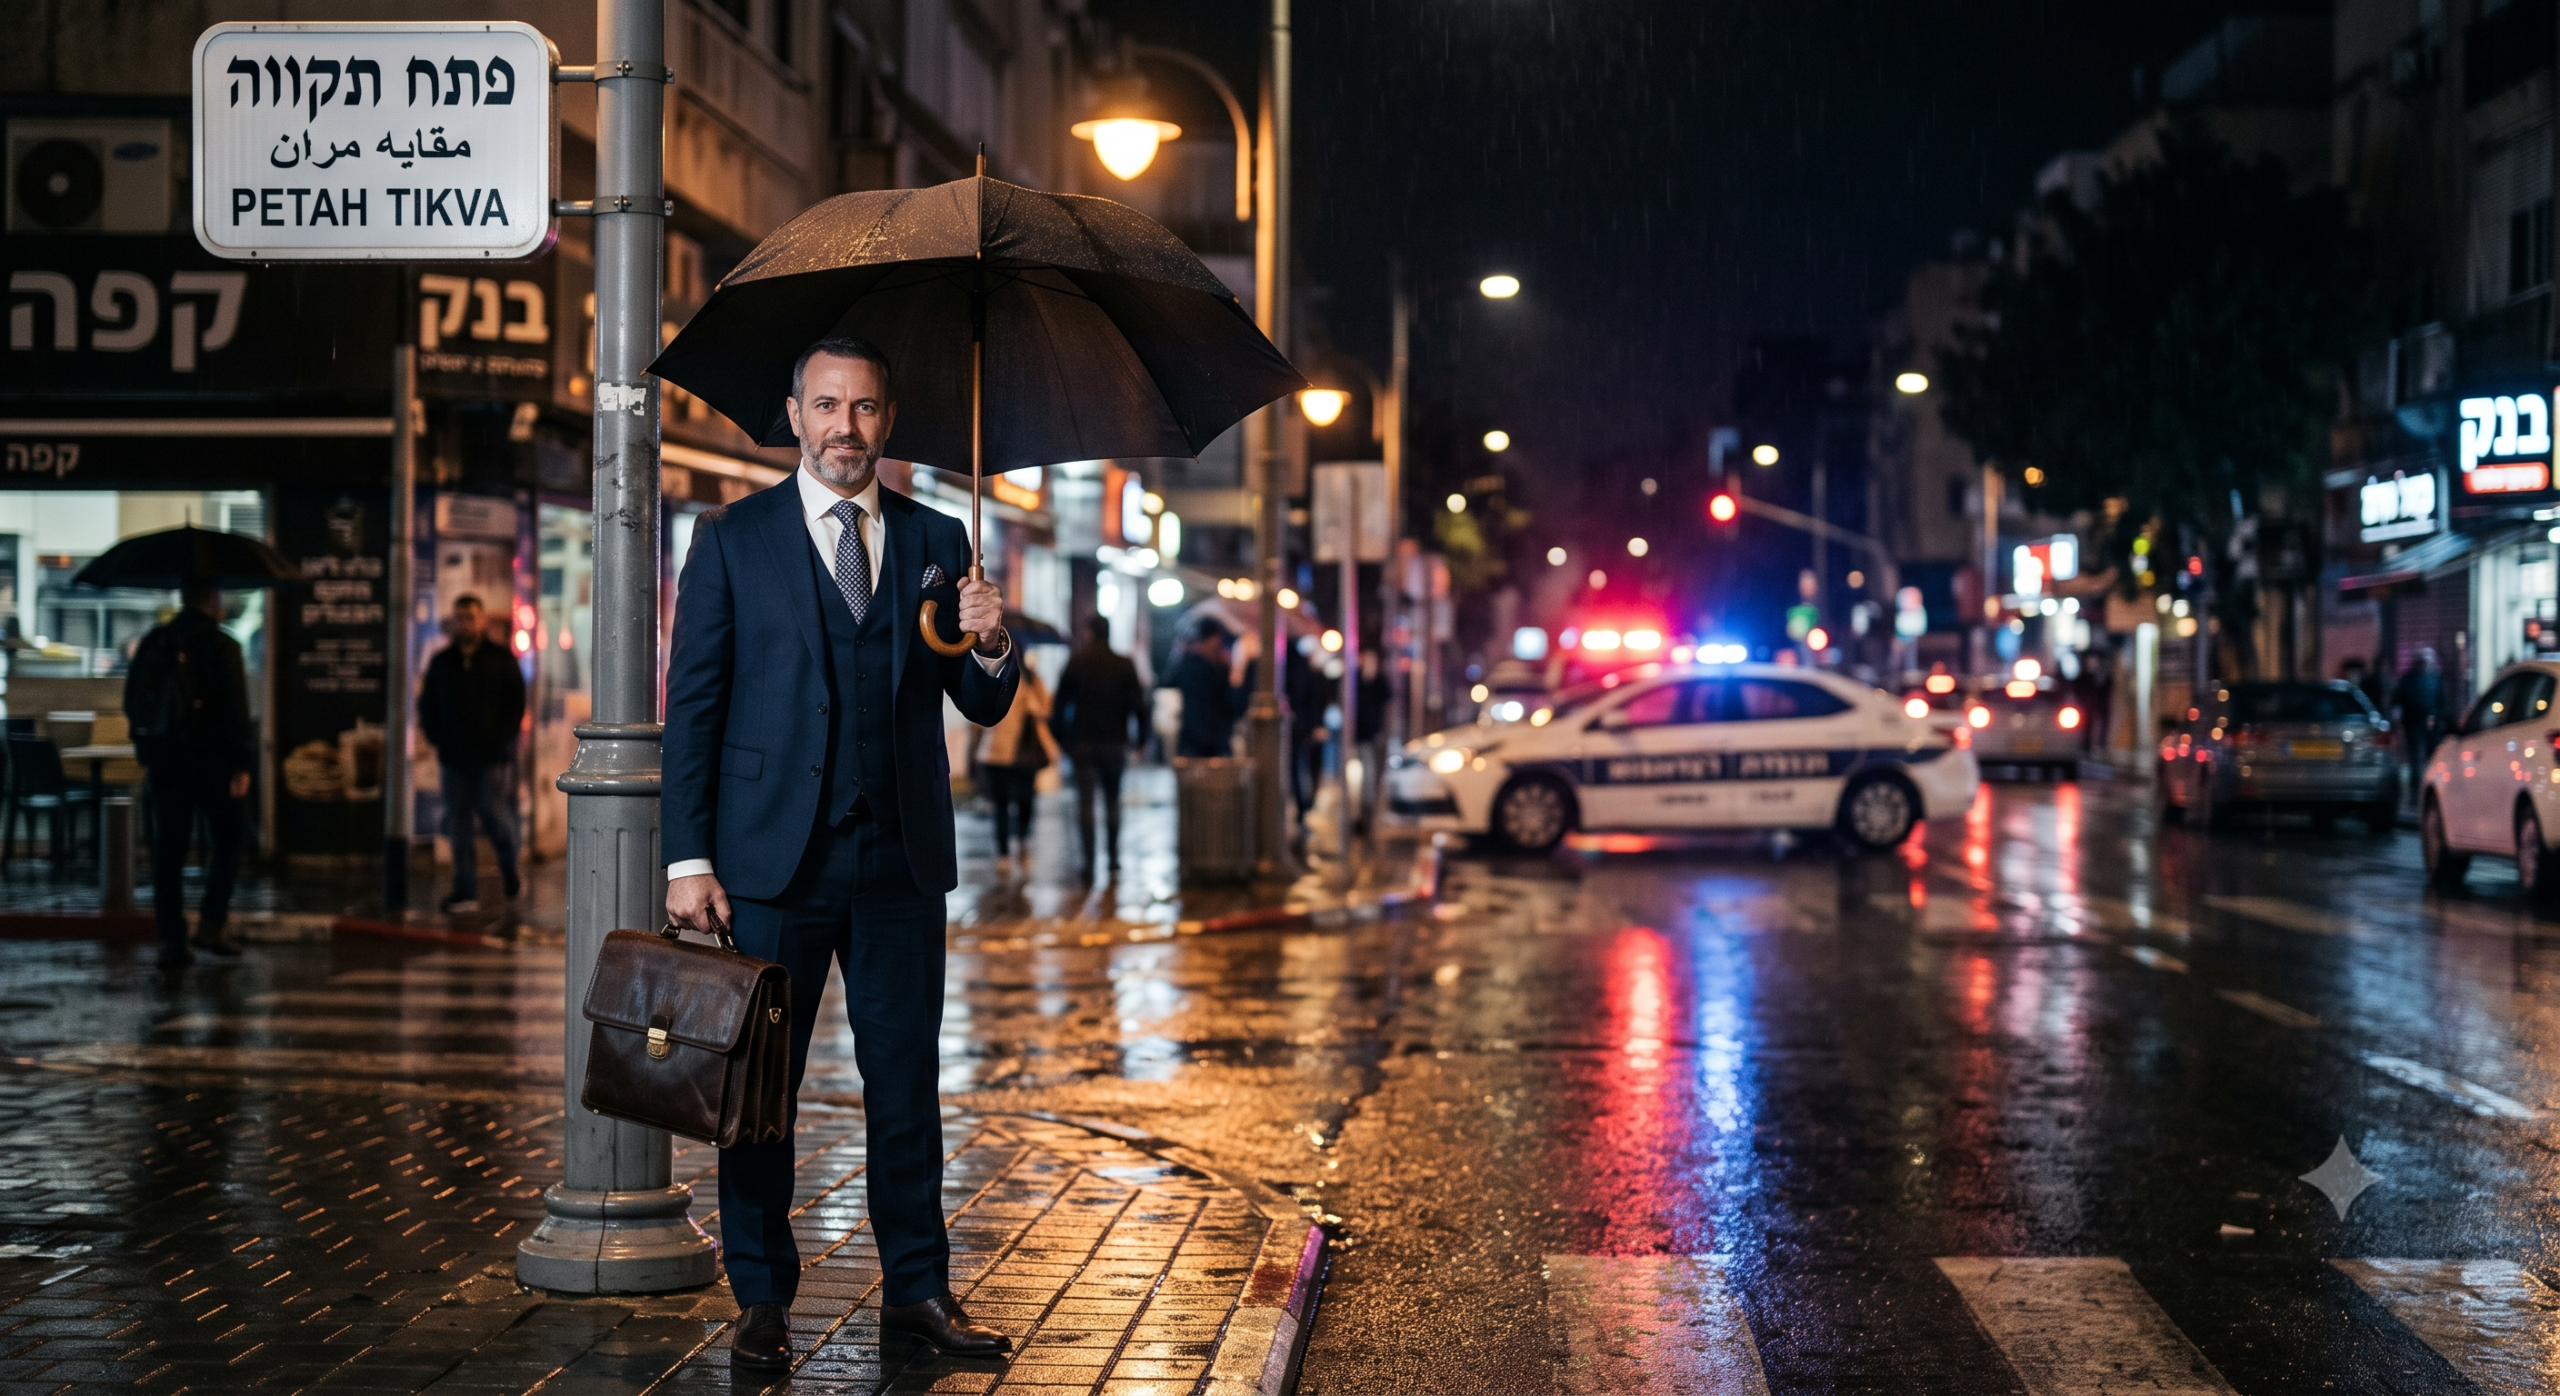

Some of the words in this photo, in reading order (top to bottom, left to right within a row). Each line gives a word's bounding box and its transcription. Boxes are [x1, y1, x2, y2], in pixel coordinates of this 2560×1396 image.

[226, 55, 382, 124] תקווה
[406, 55, 515, 108] פתח
[232, 188, 367, 226] PETAH
[386, 188, 509, 226] TIKVA
[9, 270, 247, 373] קפה
[419, 273, 549, 351] בנק
[6, 443, 80, 480] קפה
[2460, 393, 2551, 473] בנק
